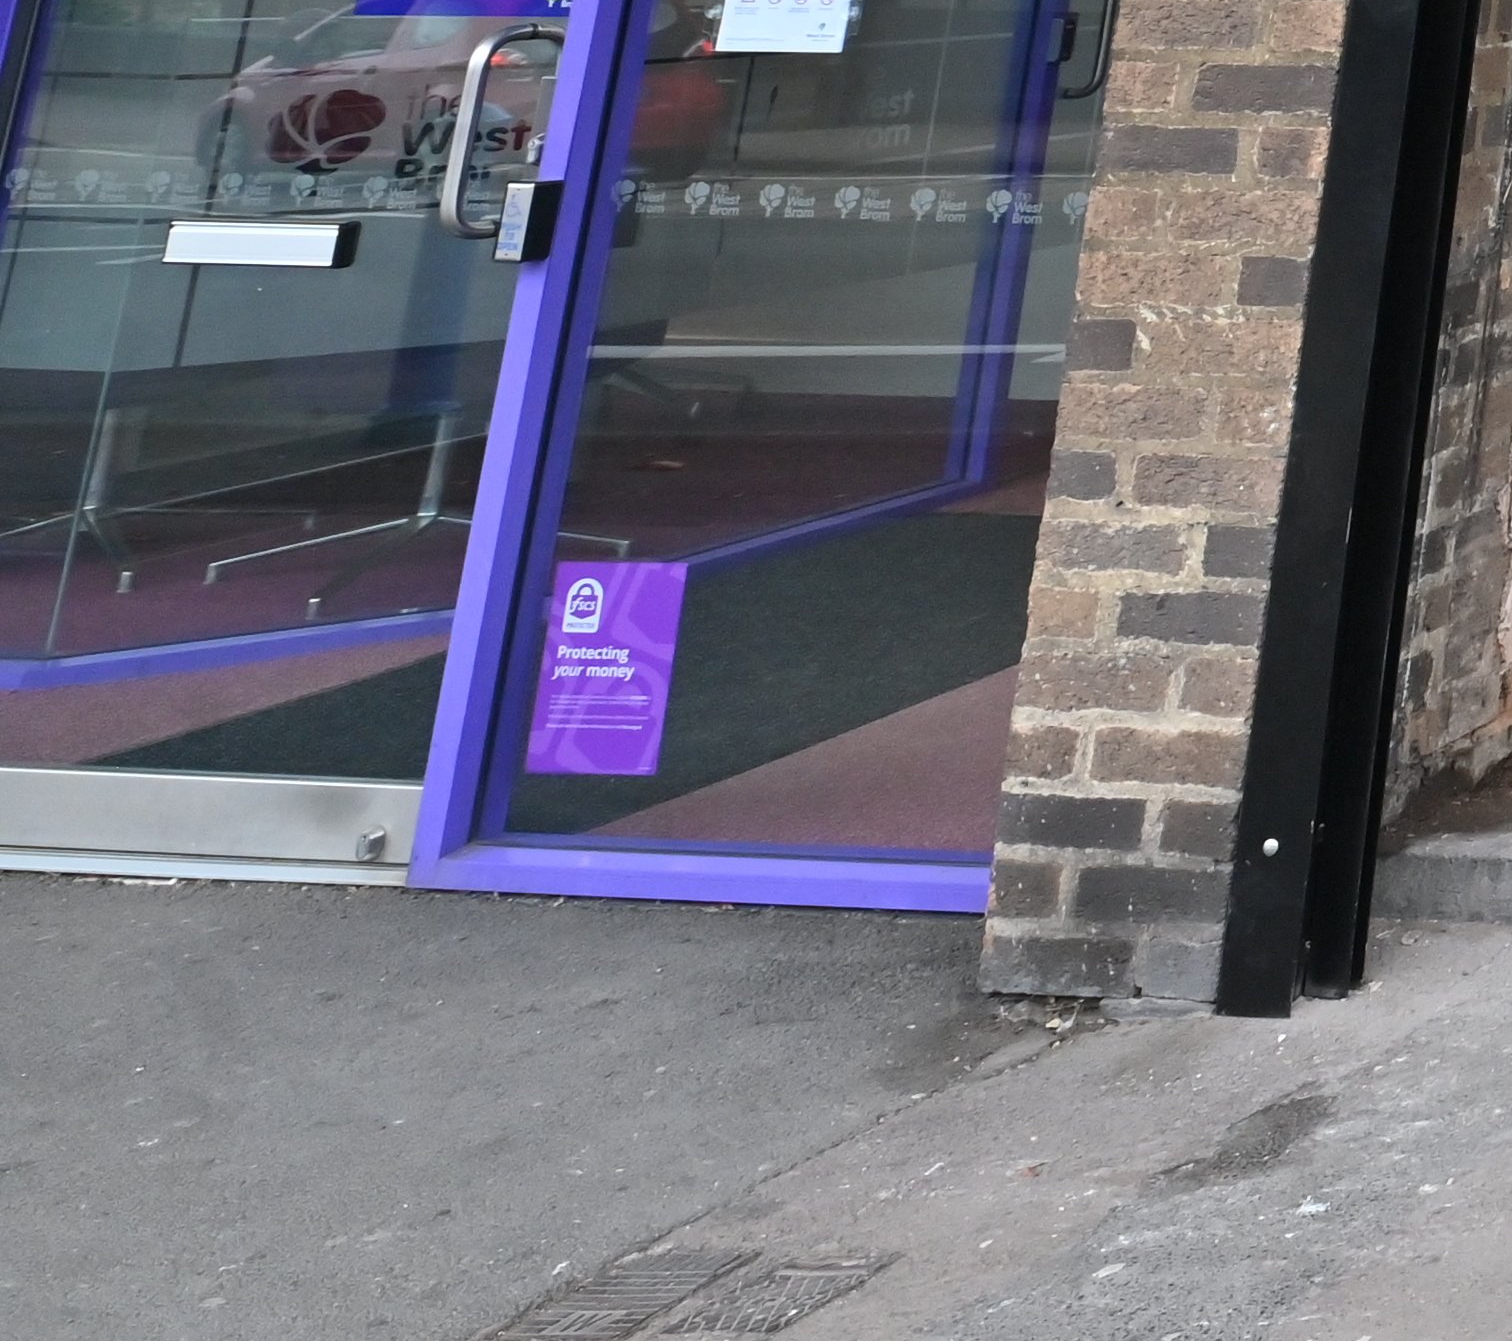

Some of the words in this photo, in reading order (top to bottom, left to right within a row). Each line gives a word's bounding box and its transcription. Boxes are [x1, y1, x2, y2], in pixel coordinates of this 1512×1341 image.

[557, 645, 630, 663] Protecting
[551, 666, 585, 680] your
[586, 666, 635, 681] money
